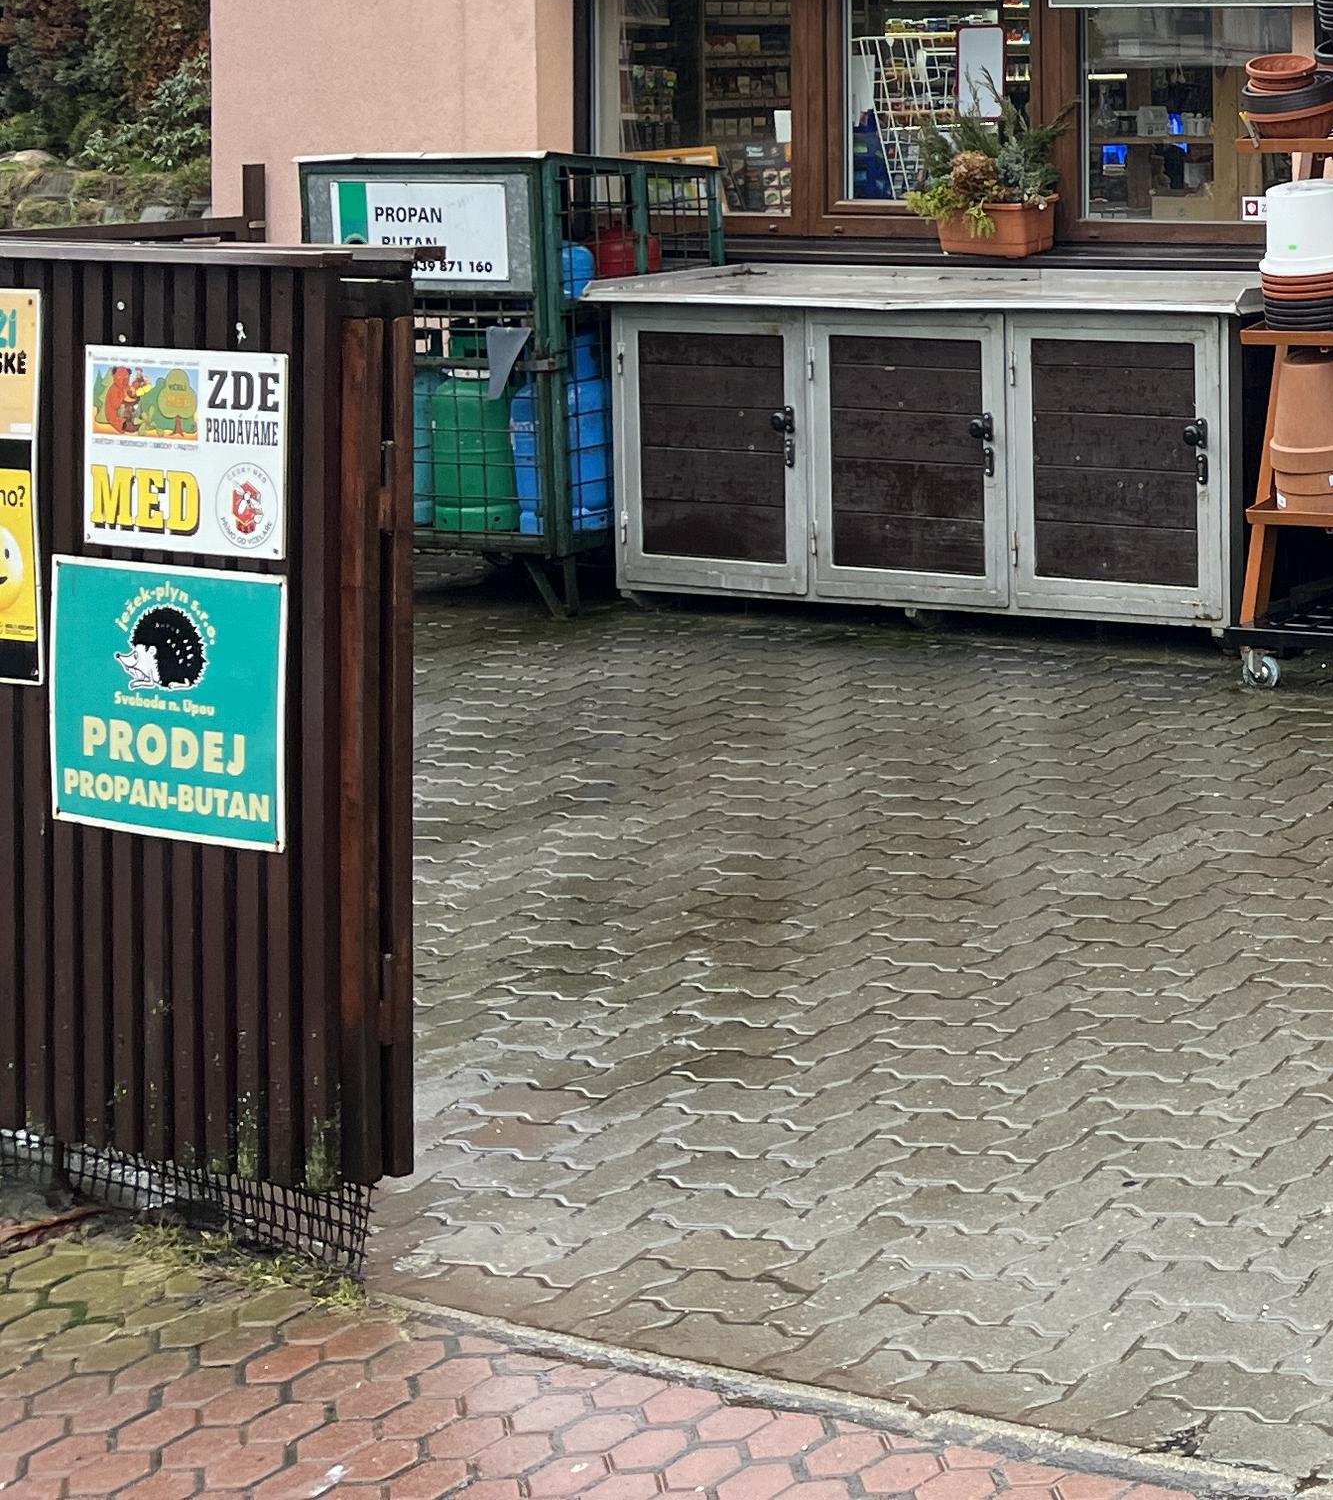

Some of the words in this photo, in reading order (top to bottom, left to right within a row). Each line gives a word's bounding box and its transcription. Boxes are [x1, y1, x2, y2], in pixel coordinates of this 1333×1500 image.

[374, 206, 442, 223] PROPAN
[469, 261, 493, 273] 160
[207, 369, 280, 412] ZDE
[206, 413, 279, 446] PRODÁVÁME
[90, 464, 201, 537] MED
[82, 715, 246, 776] PRODEJ
[63, 767, 270, 823] PROPAN-BUTAN
